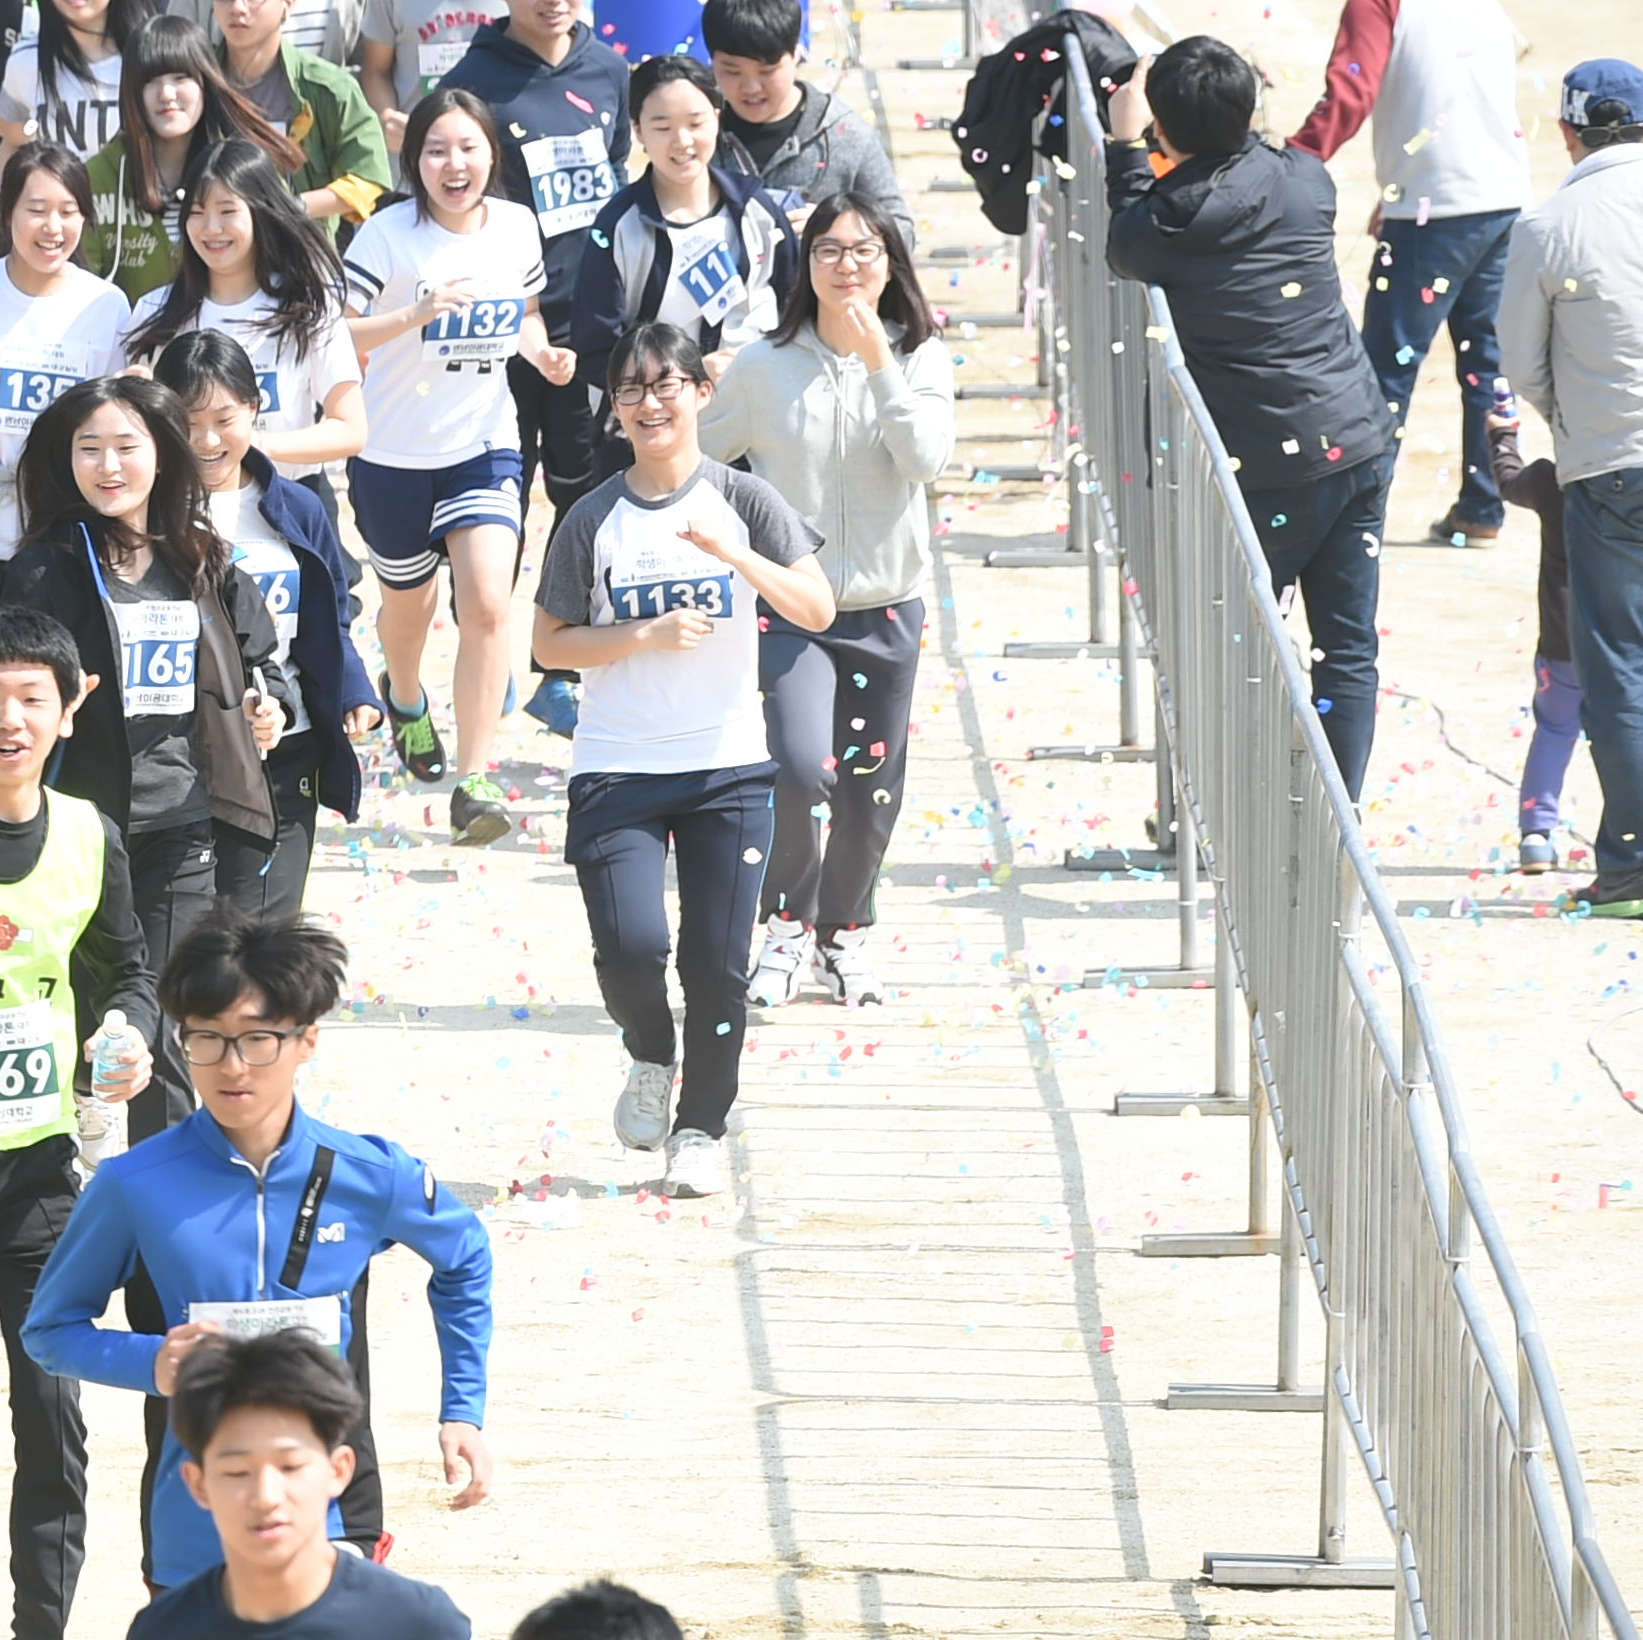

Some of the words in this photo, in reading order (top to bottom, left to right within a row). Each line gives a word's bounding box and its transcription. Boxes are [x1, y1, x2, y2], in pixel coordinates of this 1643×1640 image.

[537, 163, 615, 212] 1983
[433, 300, 518, 339] 1132
[620, 578, 724, 618] 1133
